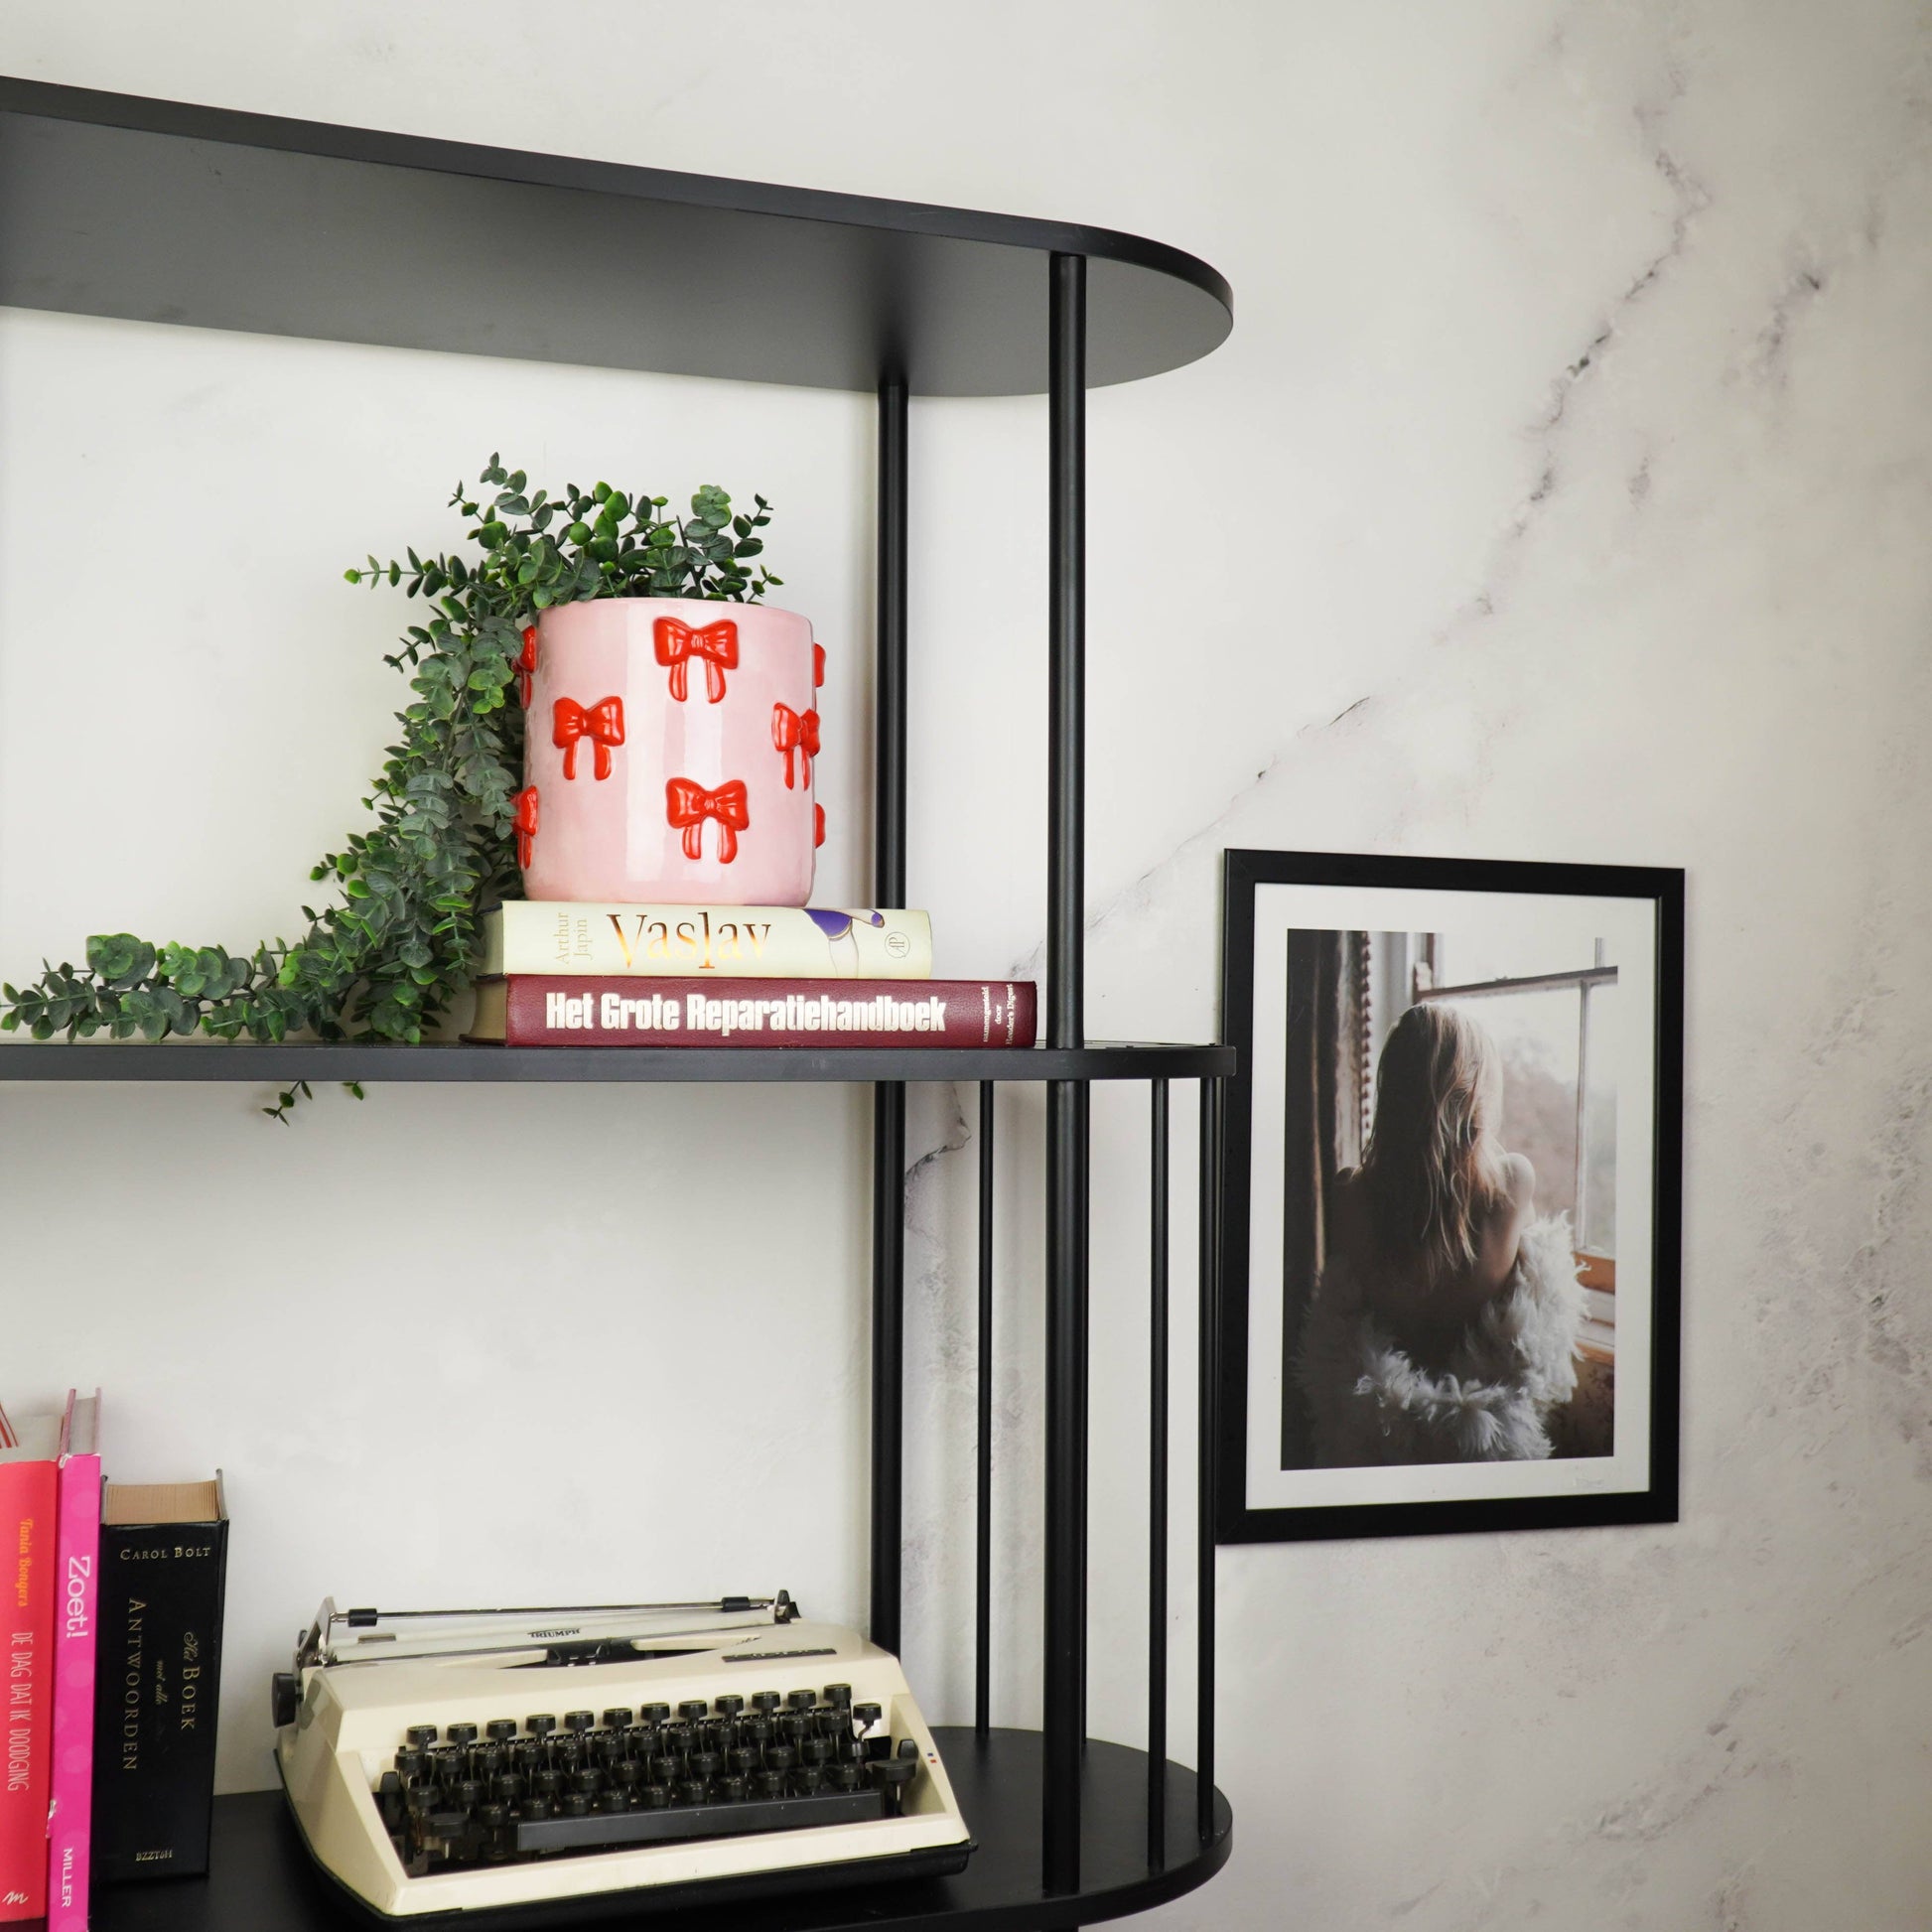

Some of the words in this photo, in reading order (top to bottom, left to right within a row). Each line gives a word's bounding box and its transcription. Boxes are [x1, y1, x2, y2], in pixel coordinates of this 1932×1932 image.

[553, 911, 570, 965] Arthur
[573, 918, 593, 960] Japin
[607, 911, 771, 969] Vaslav
[546, 993, 593, 1030] Het
[601, 993, 680, 1031] Grote
[687, 994, 946, 1036] Reparatiehandboek
[19, 1518, 33, 1555] Tania
[120, 1548, 168, 1561] CAROL
[175, 1547, 211, 1559] BOLT
[15, 1557, 32, 1607] Bongers
[67, 1556, 90, 1638] Zoet!
[11, 1632, 33, 1647] DE
[527, 1628, 580, 1638] TRIUMPH
[10, 1652, 33, 1678] DAG
[122, 1596, 146, 1770] ANTWOORDEN
[10, 1684, 33, 1706] DAT
[10, 1710, 32, 1723] IK
[181, 1666, 200, 1730] BOEK
[8, 1728, 31, 1791] DOODGING
[62, 1848, 73, 1907] MILLER
